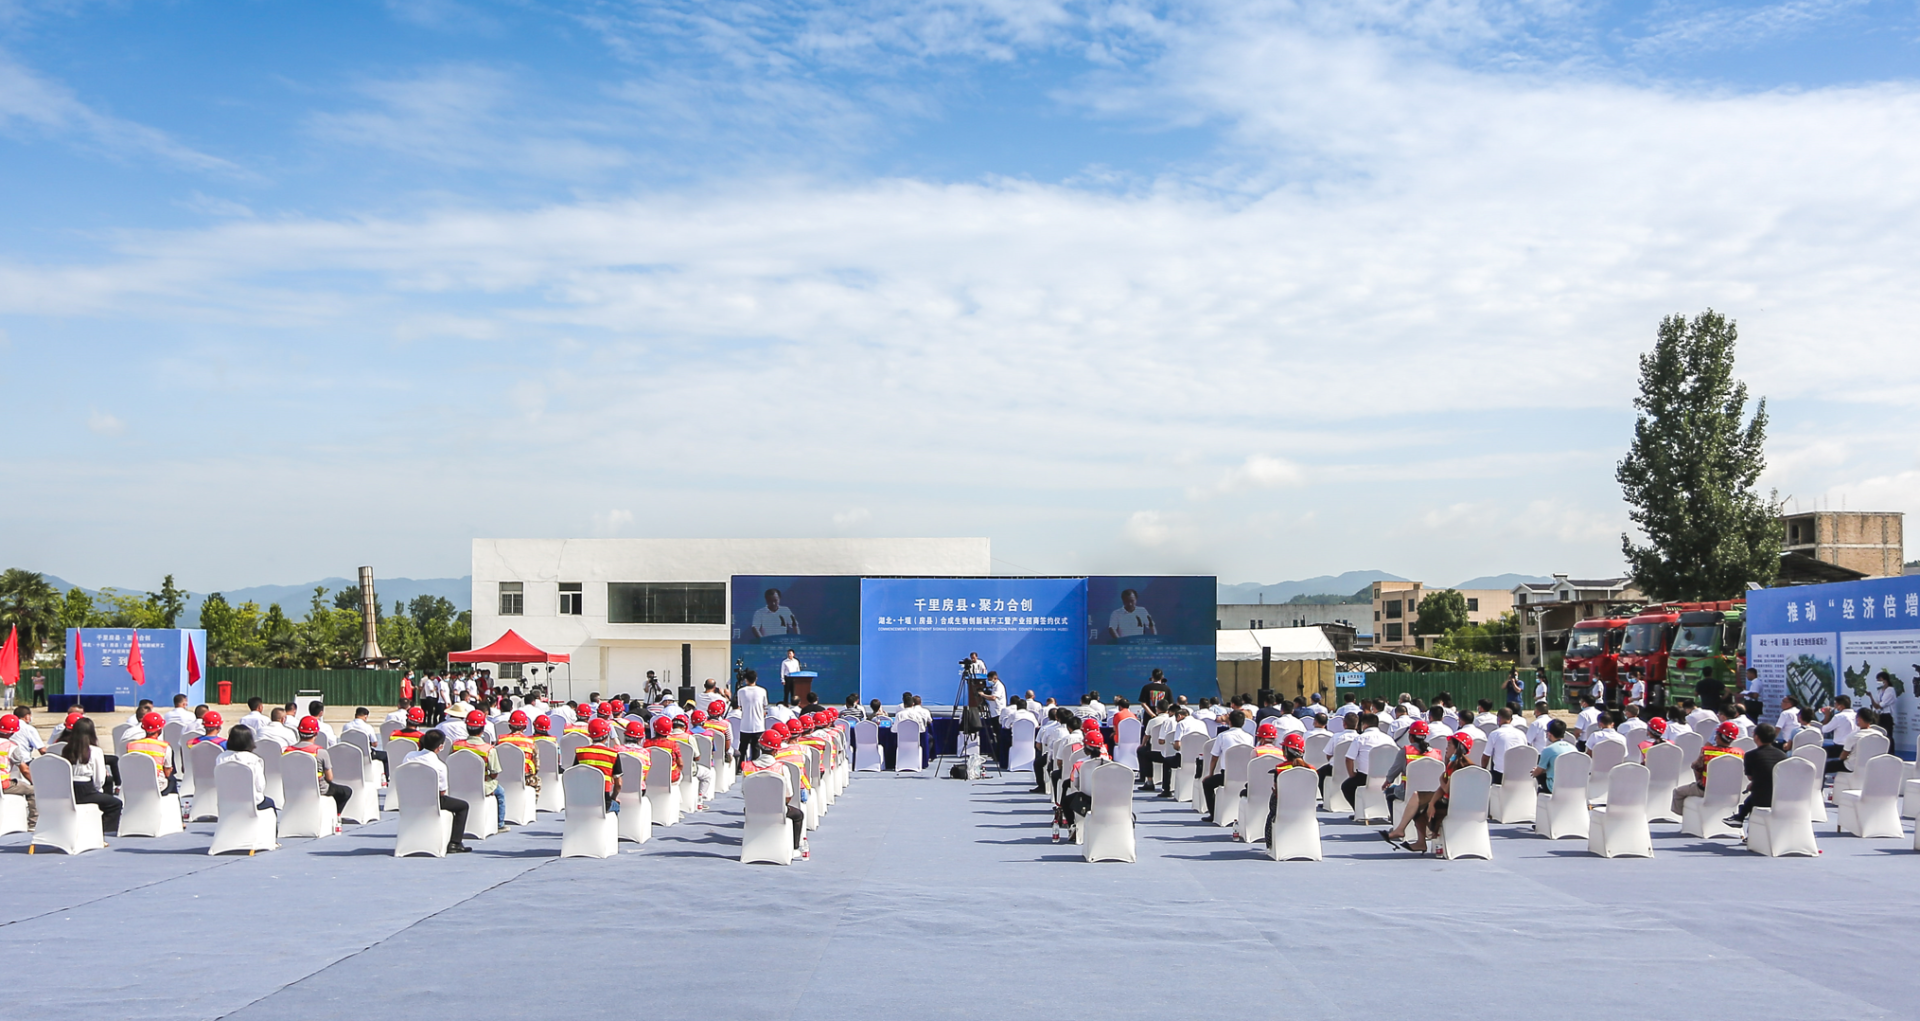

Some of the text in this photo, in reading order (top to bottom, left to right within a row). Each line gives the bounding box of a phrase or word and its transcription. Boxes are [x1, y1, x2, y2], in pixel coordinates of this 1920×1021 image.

[914, 598, 1033, 612] 千里房县·聚力合创
[102, 656, 145, 666] 签到
